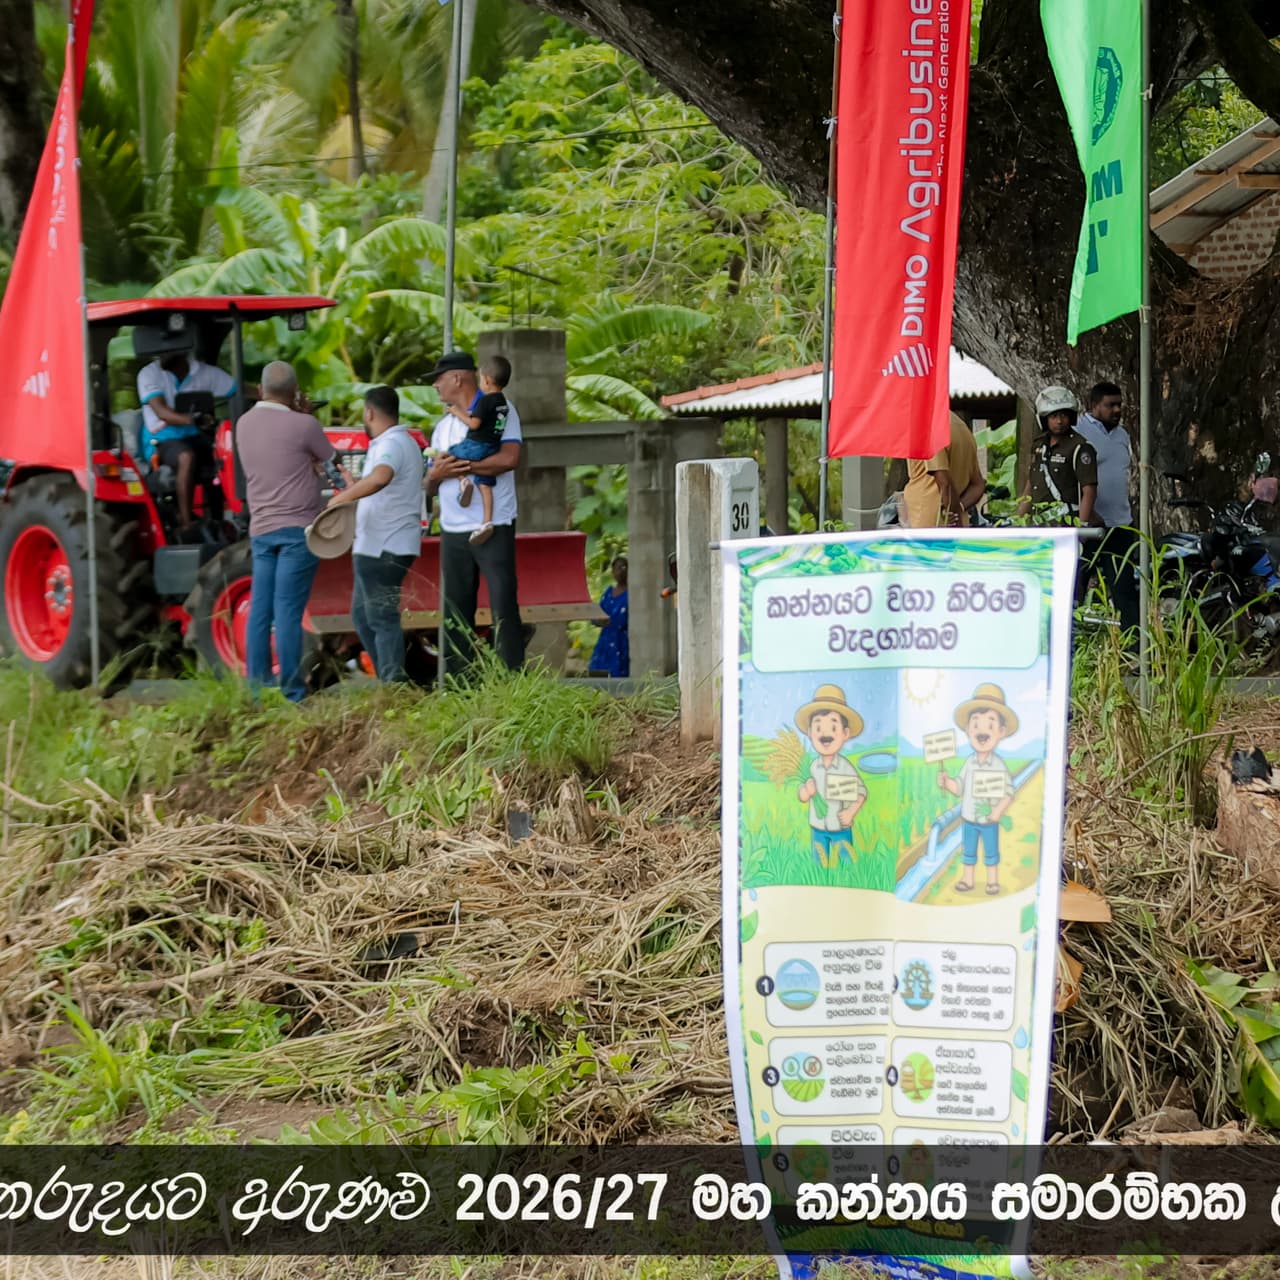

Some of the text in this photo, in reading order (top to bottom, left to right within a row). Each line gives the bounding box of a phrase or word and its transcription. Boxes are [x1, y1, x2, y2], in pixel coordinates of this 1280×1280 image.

[900, 254, 929, 337] DIMO
[732, 502, 749, 532] 30
[767, 582, 1027, 619] කන්නයට වගා කිරීමේ
